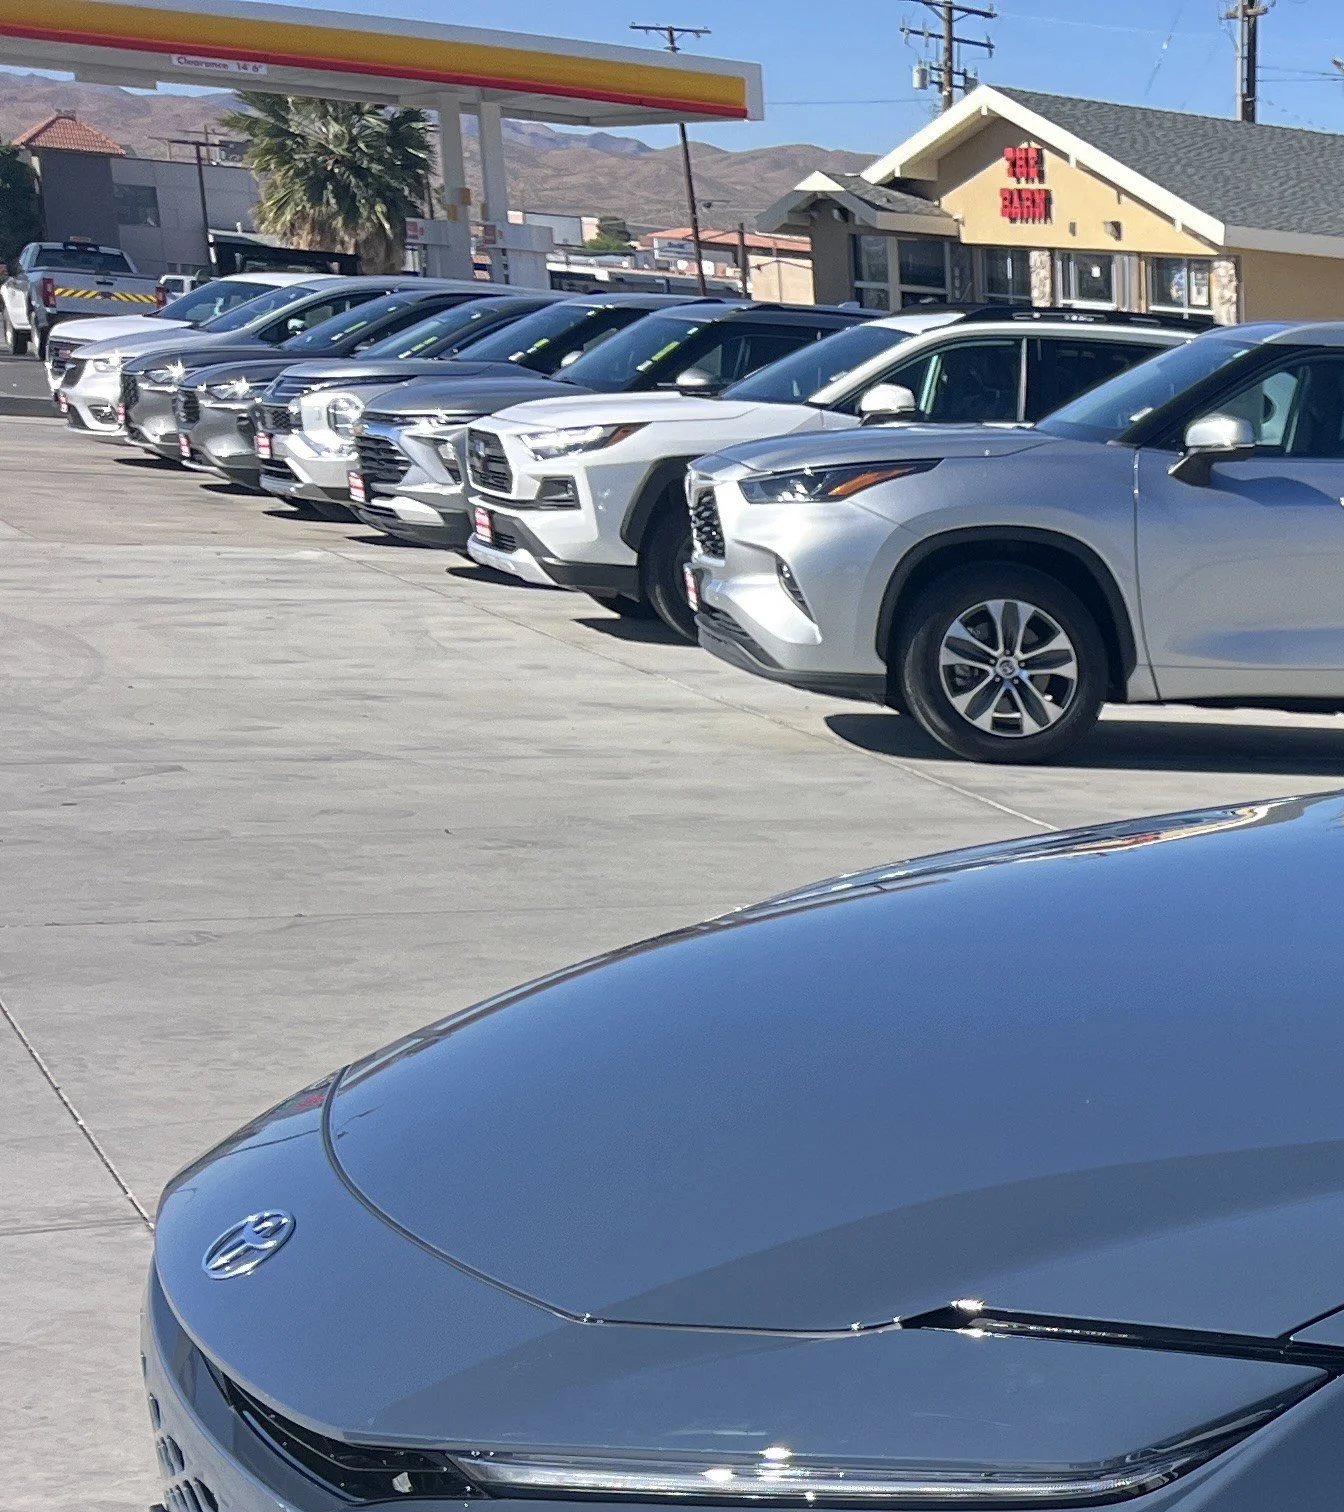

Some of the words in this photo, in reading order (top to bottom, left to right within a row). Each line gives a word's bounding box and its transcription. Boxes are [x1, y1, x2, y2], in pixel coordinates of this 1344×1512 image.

[177, 56, 229, 70] Clearance
[1003, 146, 1042, 180] THE
[999, 187, 1048, 220] BARN
